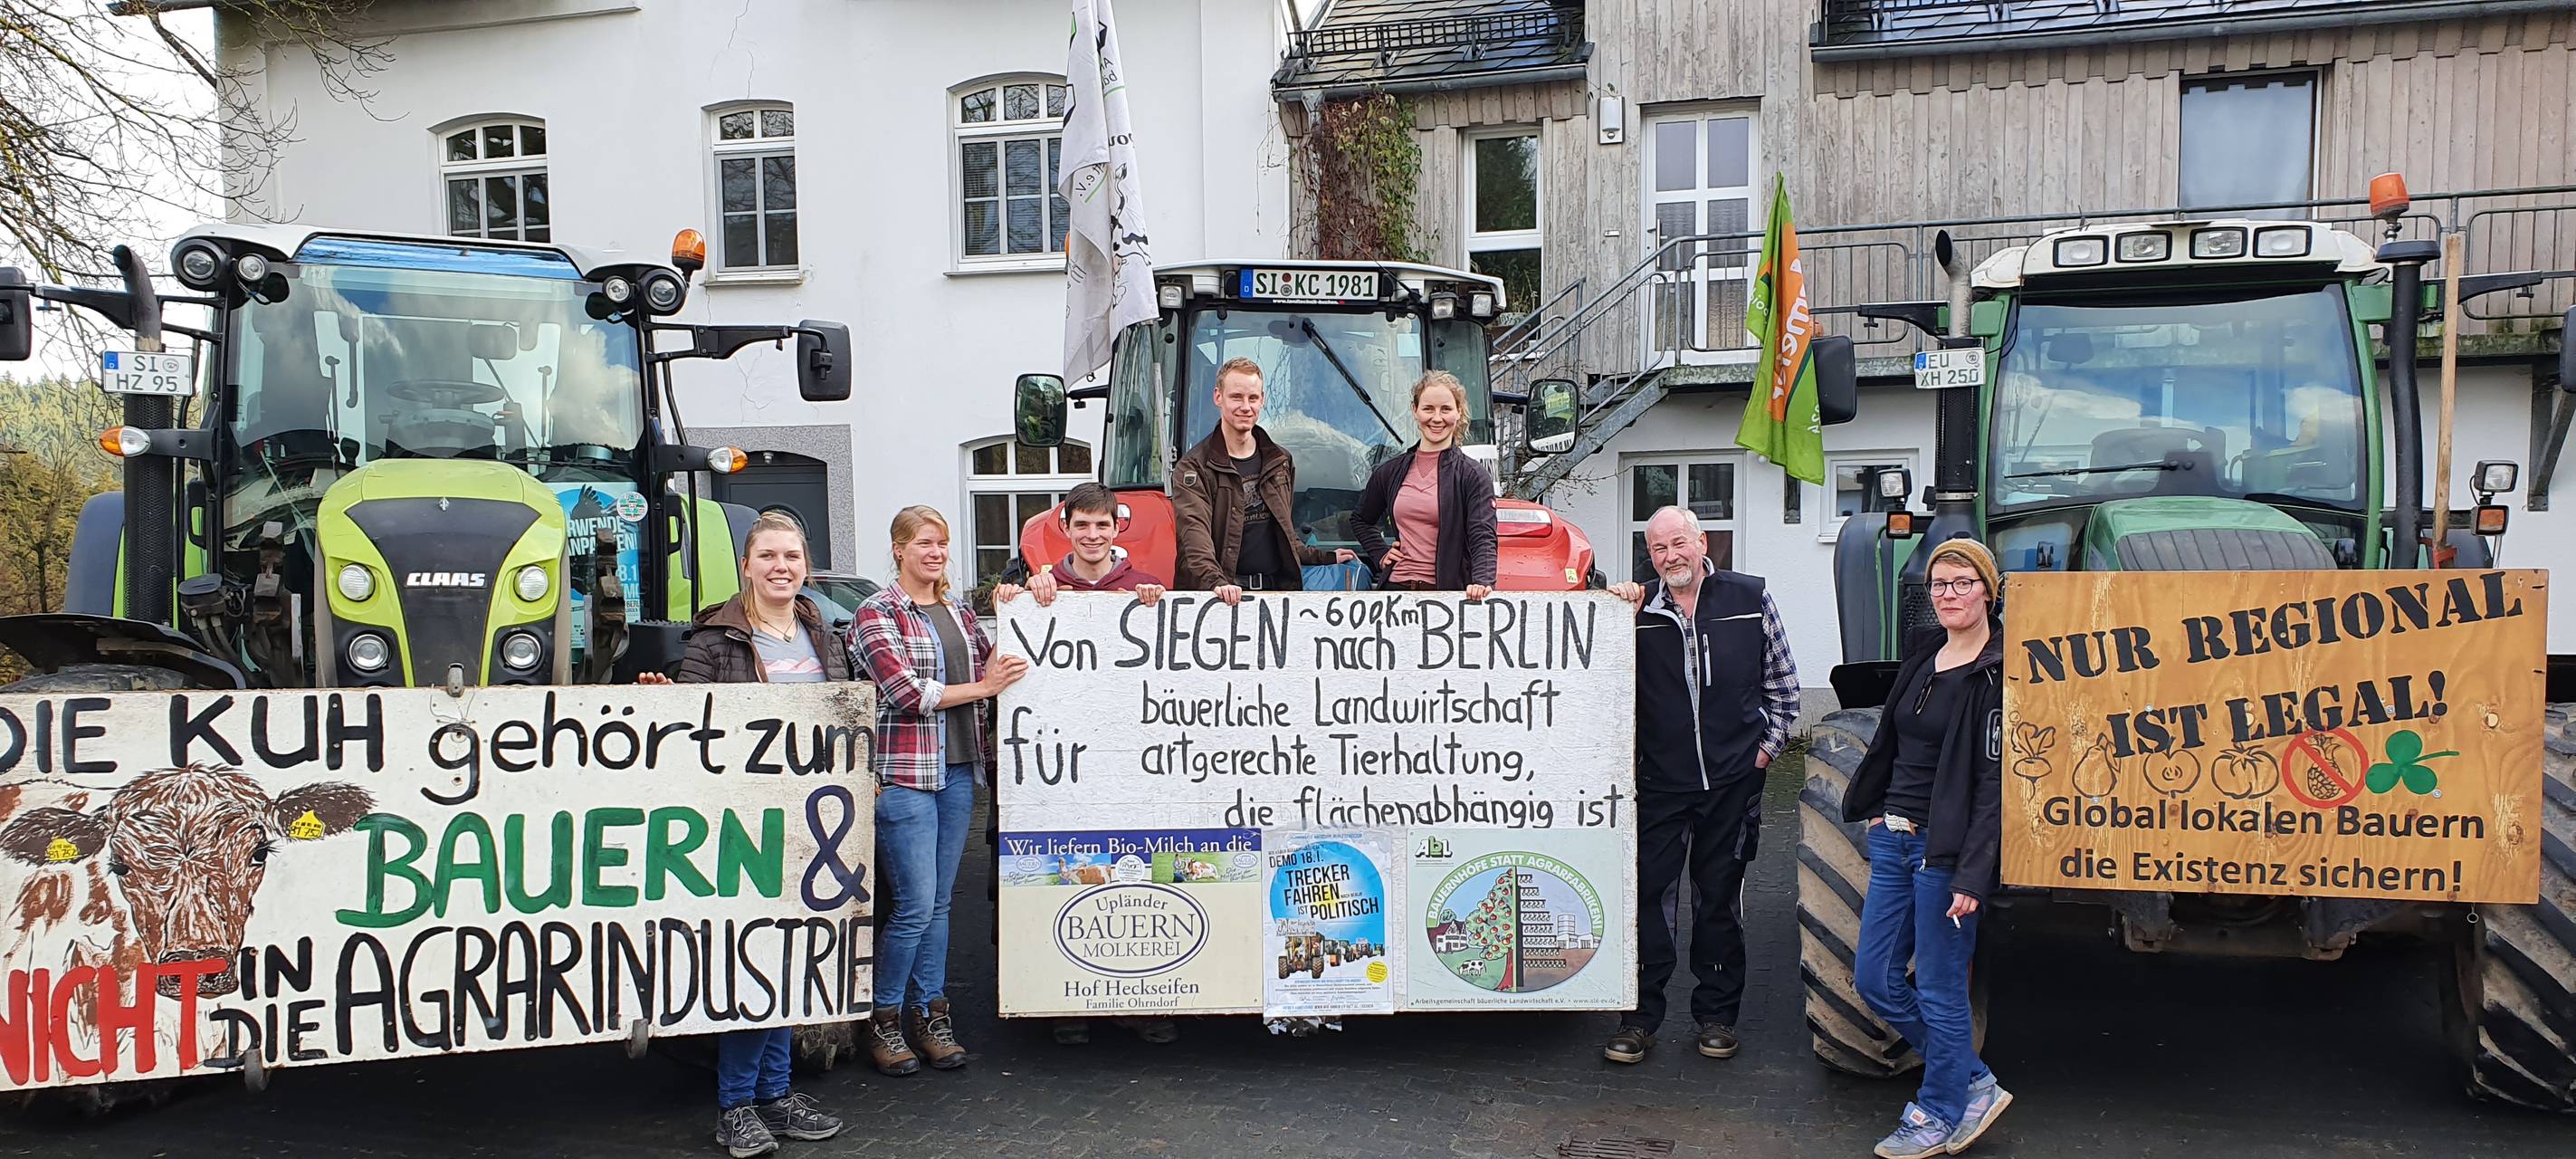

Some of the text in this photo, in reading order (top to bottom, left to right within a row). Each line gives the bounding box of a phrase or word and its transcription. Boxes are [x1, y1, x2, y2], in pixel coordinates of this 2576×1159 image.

[1255, 273, 1374, 297] SI KC 1981
[134, 355, 159, 373] SI
[1928, 353, 1950, 369] EU
[116, 373, 178, 392] HZ 95
[1921, 369, 1979, 387] XH 250
[568, 516, 625, 538] RWENDE
[406, 572, 486, 587] CLAAS
[1010, 596, 1597, 671] Von SIEGEN nach BERLIN
[2022, 571, 2524, 685] NUR REGIONAL
[1140, 676, 1561, 731] bäuerliche Landwirtschaft
[2106, 670, 2448, 759] IST LEGAL!
[170, 693, 384, 772] KUH
[421, 690, 726, 806] gehört
[745, 718, 874, 776] zum
[1004, 706, 1087, 785] für
[1141, 732, 1535, 783] artgerechte Tierhaltung,
[1225, 783, 1624, 829] die flächenabhängig ist
[2042, 796, 2485, 838] Global lokalen Bauern
[336, 785, 871, 928] BAUERN &
[1007, 835, 1253, 856] Wir liefern Bio-Milch an die
[1269, 854, 1297, 868] DEMO
[1490, 855, 1524, 867] STATT
[2059, 848, 2463, 894] die Existenz sichern!
[1285, 864, 1350, 887] TRECKER
[1095, 892, 1169, 914] Upländer
[1283, 883, 1340, 906] FAHREN
[1297, 896, 1379, 921] IST POLITISCH
[1067, 913, 1196, 941] BAUERN
[1083, 941, 1181, 959] MOLKEREI
[240, 936, 313, 1001] IN
[336, 916, 874, 1056] AGRARINDUSTRIE
[1064, 978, 1200, 997] Hof Heckseifen
[1086, 997, 1180, 1010] Familie Ohrndorf
[0, 958, 228, 1086] NICHT
[204, 1000, 328, 1068] DIE
